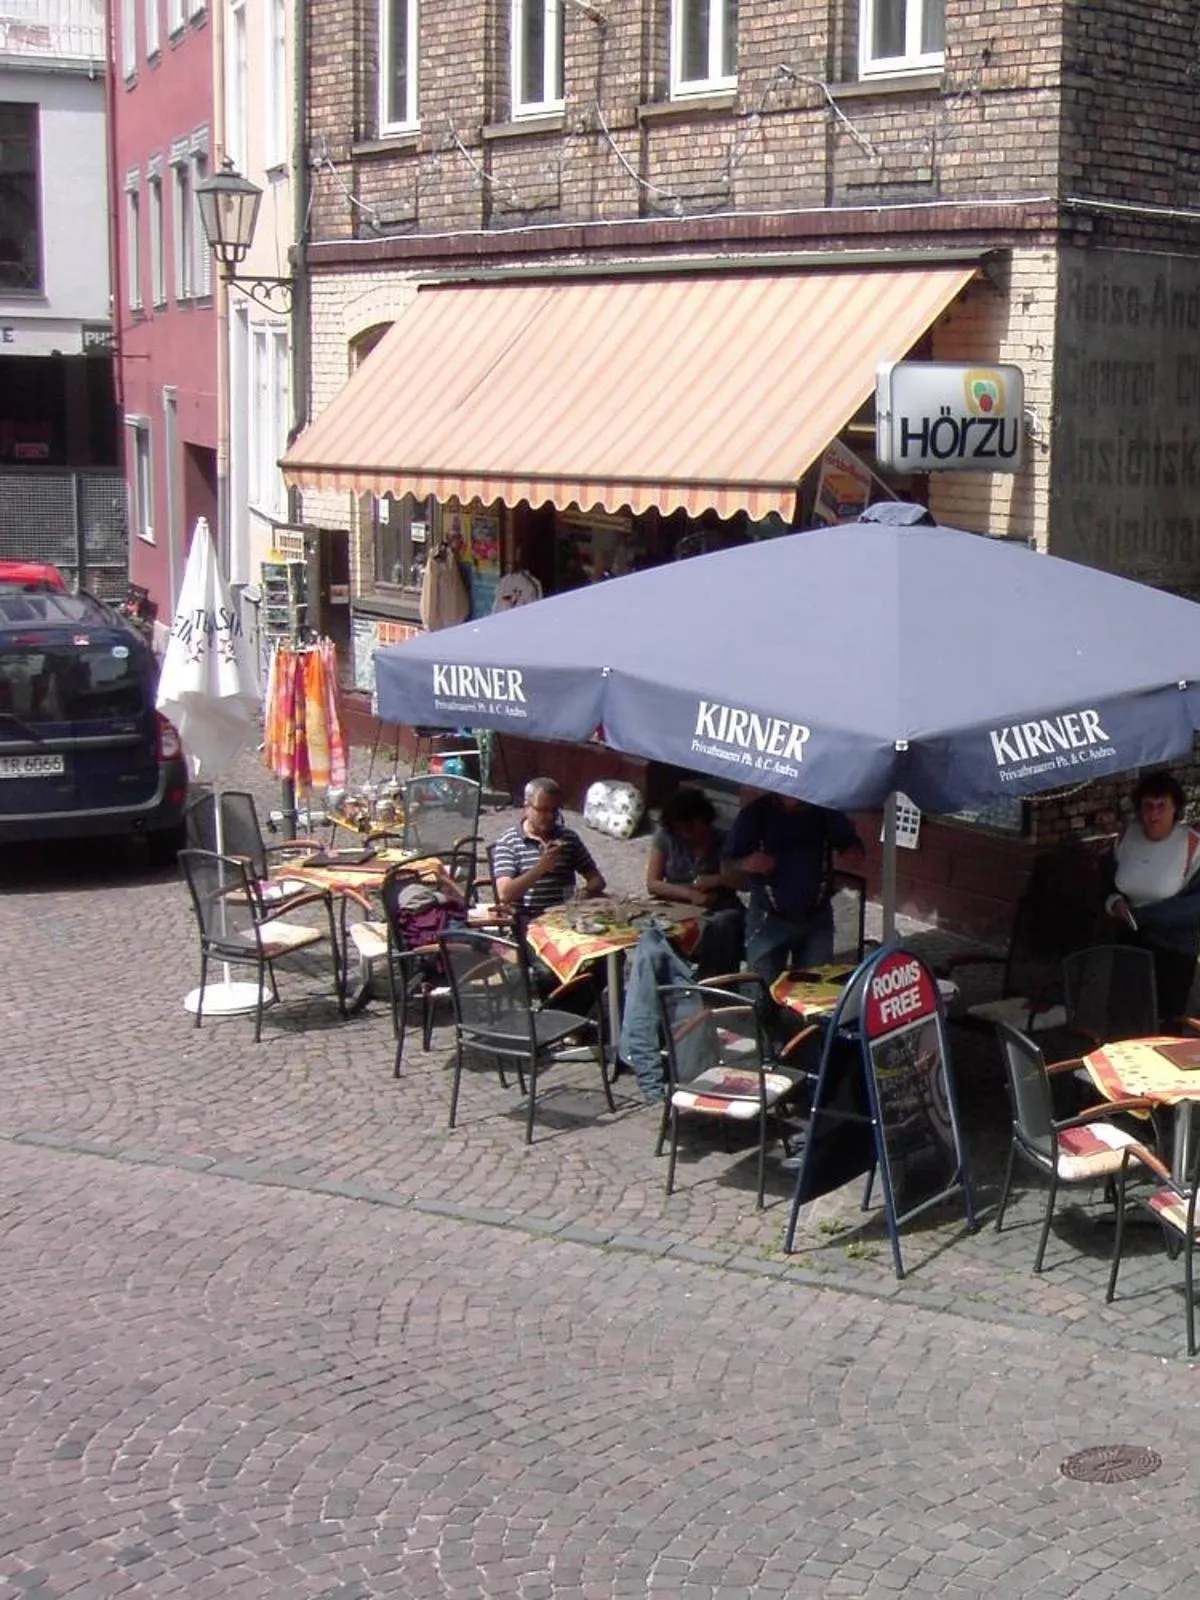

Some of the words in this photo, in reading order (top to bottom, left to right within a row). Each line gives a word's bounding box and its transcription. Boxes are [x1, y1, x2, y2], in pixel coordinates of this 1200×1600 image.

[433, 663, 528, 703] KIRNER
[695, 700, 811, 762] KIRNER
[989, 709, 1110, 766] KIRNER
[872, 960, 921, 999] ROOMS
[879, 987, 922, 1024] FREE
